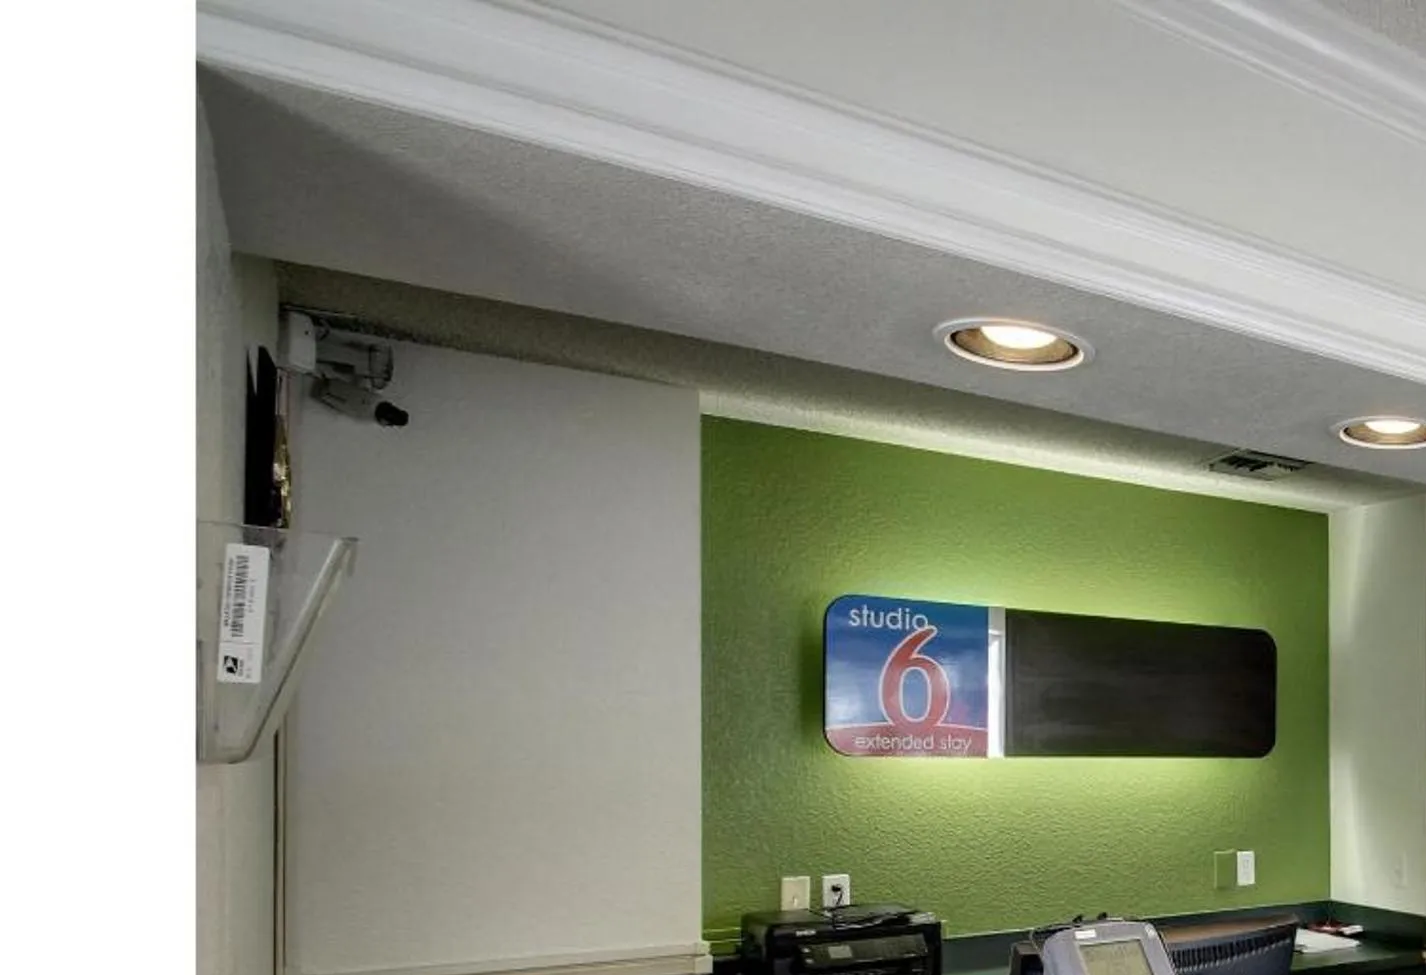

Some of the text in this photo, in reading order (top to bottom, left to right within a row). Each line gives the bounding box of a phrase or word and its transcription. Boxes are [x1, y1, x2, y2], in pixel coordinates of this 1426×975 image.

[848, 604, 928, 630] studio
[878, 625, 950, 728] 6
[855, 734, 972, 751] extended stay
